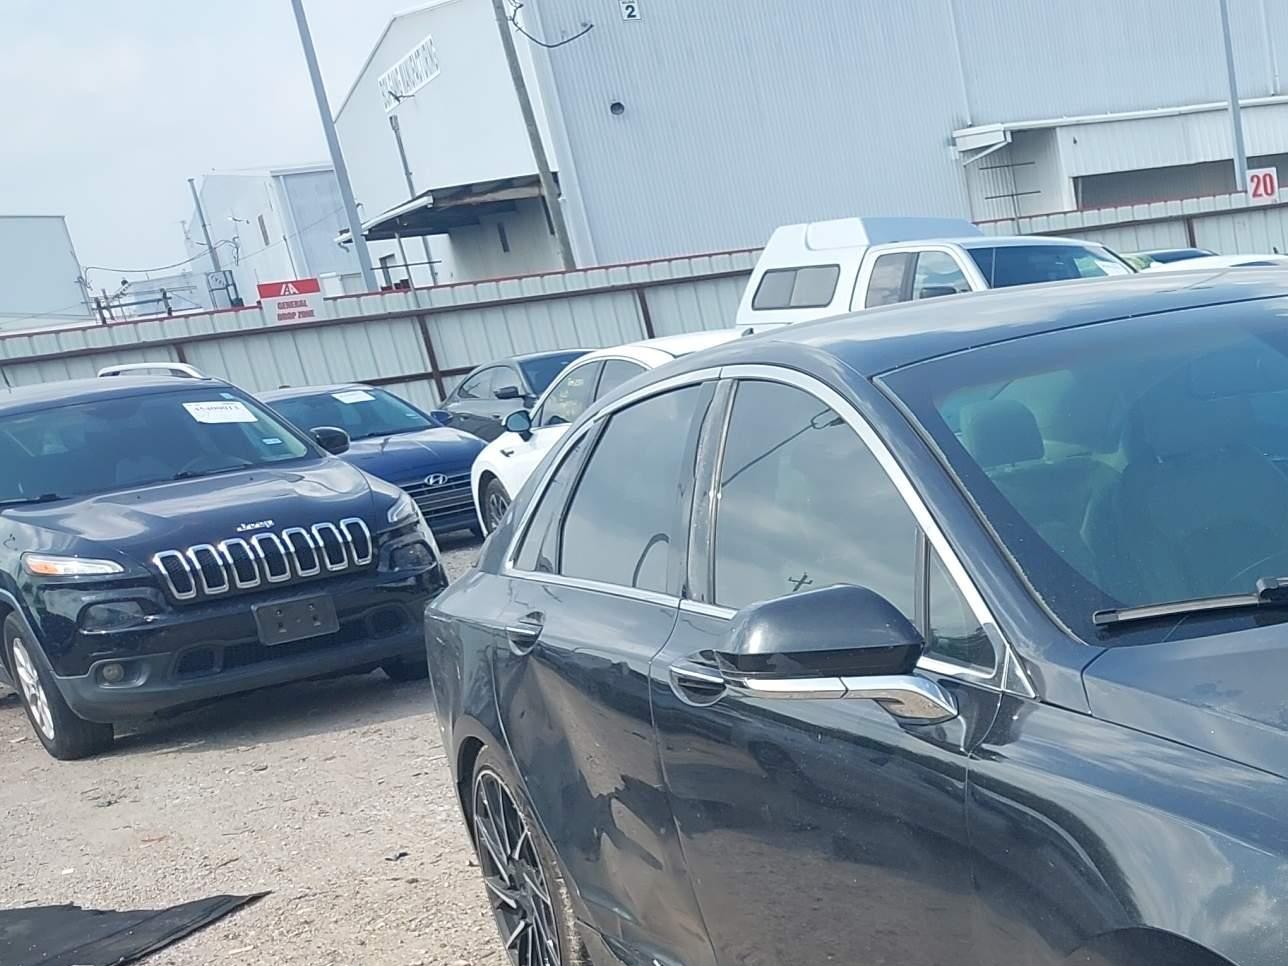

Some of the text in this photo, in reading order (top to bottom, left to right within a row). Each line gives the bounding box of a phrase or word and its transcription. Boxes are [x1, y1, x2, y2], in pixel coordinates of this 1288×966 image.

[625, 4, 637, 19] 2
[1250, 173, 1275, 198] 20
[277, 300, 308, 310] GENERAL
